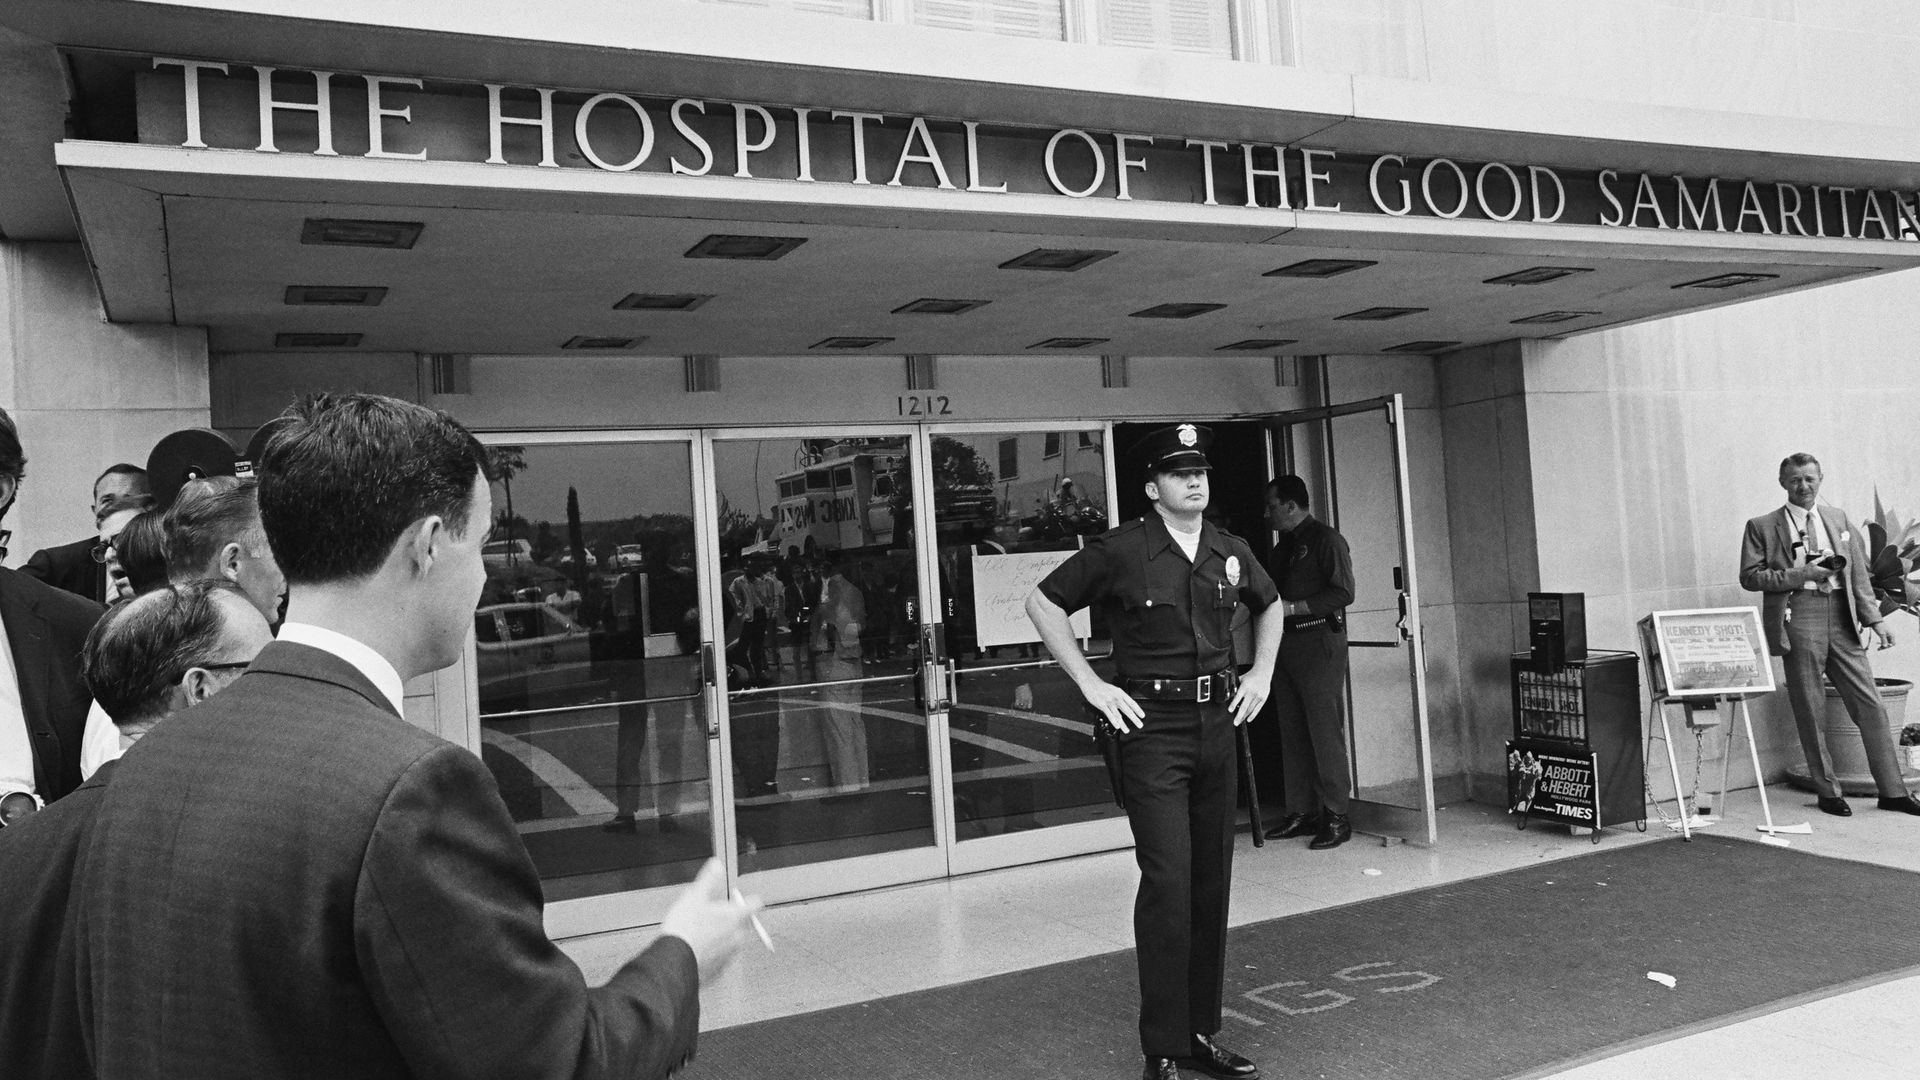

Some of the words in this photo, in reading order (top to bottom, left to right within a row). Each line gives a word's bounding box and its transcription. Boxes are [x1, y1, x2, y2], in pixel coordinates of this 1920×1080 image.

[152, 56, 428, 162] THE
[483, 83, 1008, 193] HOSPITAL
[1044, 127, 1154, 200] OF
[1185, 138, 1341, 212] THE
[1369, 154, 1567, 224] GOOD
[897, 394, 953, 416] 1212
[1665, 625, 1712, 637] KENNEDY
[1522, 696, 1554, 711] KENNEDY
[1544, 765, 1591, 783] ABBOTT
[1540, 781, 1548, 792] &
[1548, 779, 1592, 798] HEBERT
[1555, 803, 1593, 820] TIMES
[1221, 961, 1443, 1027] GS
